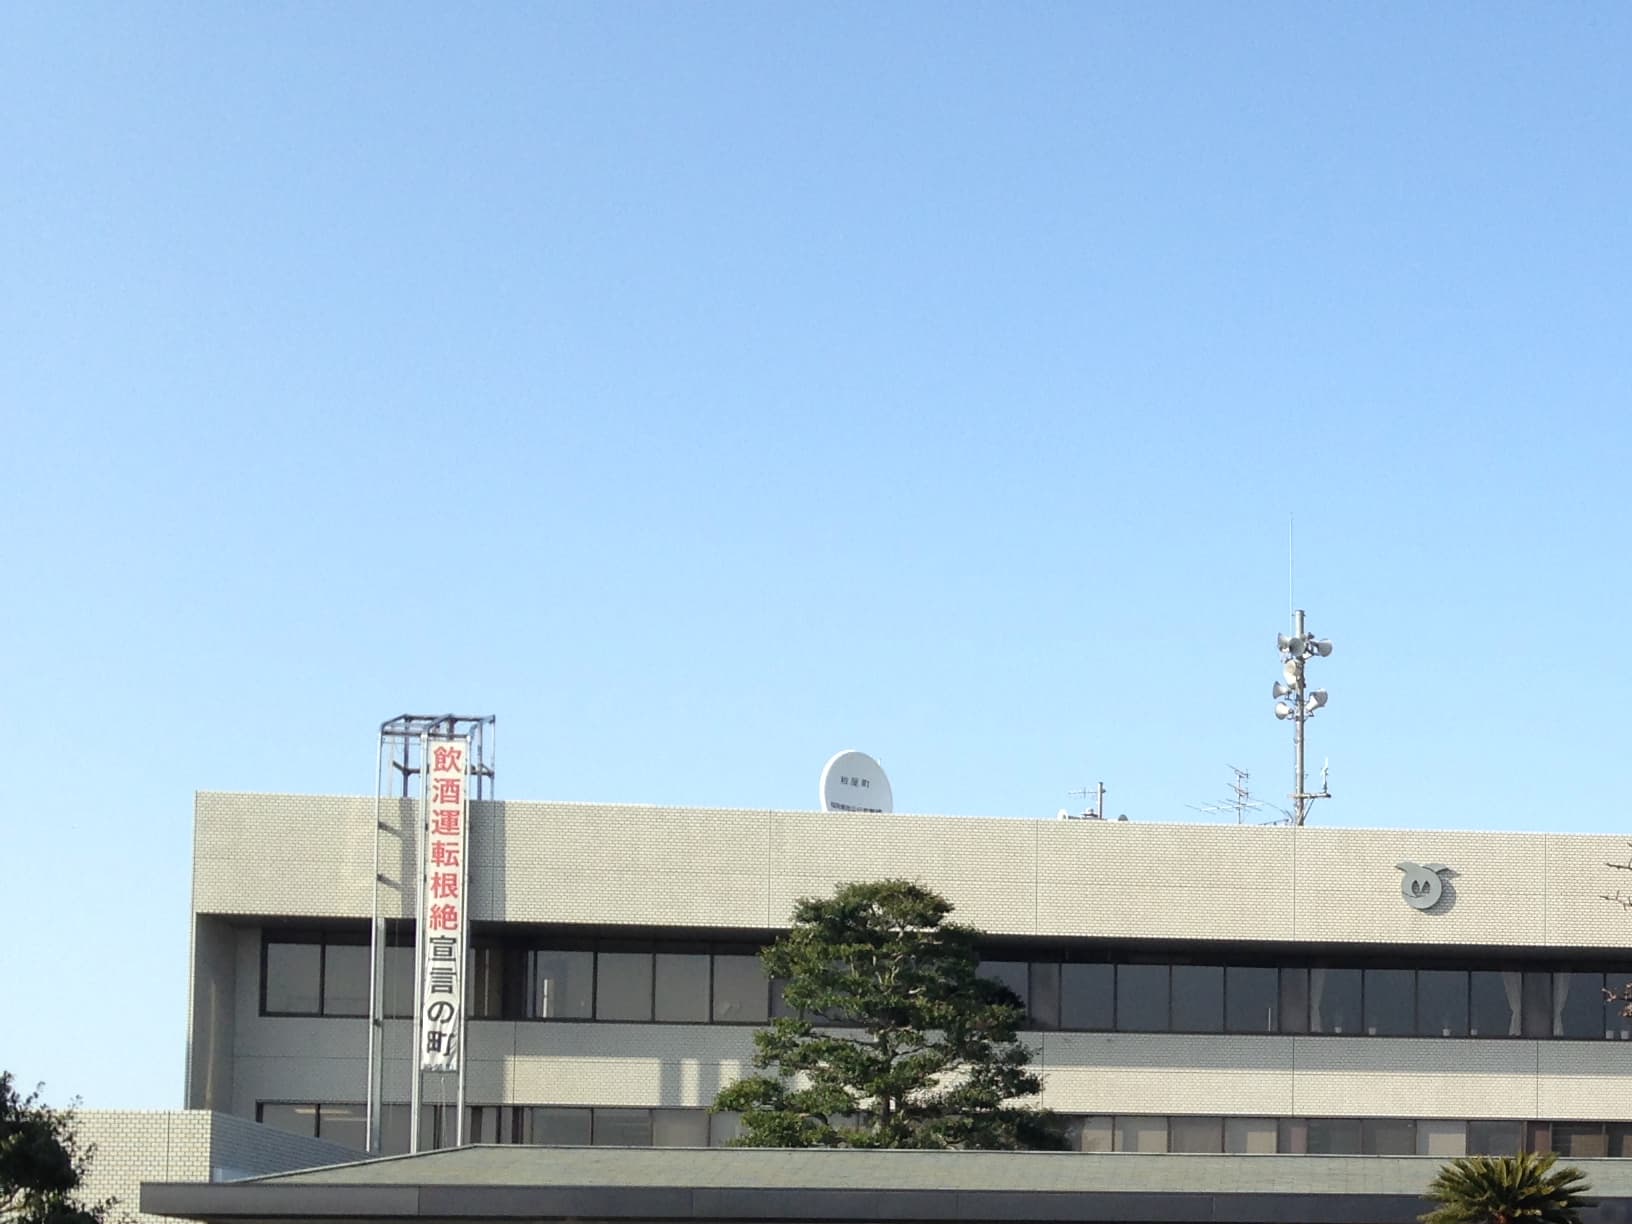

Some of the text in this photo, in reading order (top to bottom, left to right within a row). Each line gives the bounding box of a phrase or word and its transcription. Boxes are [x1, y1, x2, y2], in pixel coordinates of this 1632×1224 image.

[427, 746, 462, 1057] 飲酒運転根絶宣言の町
